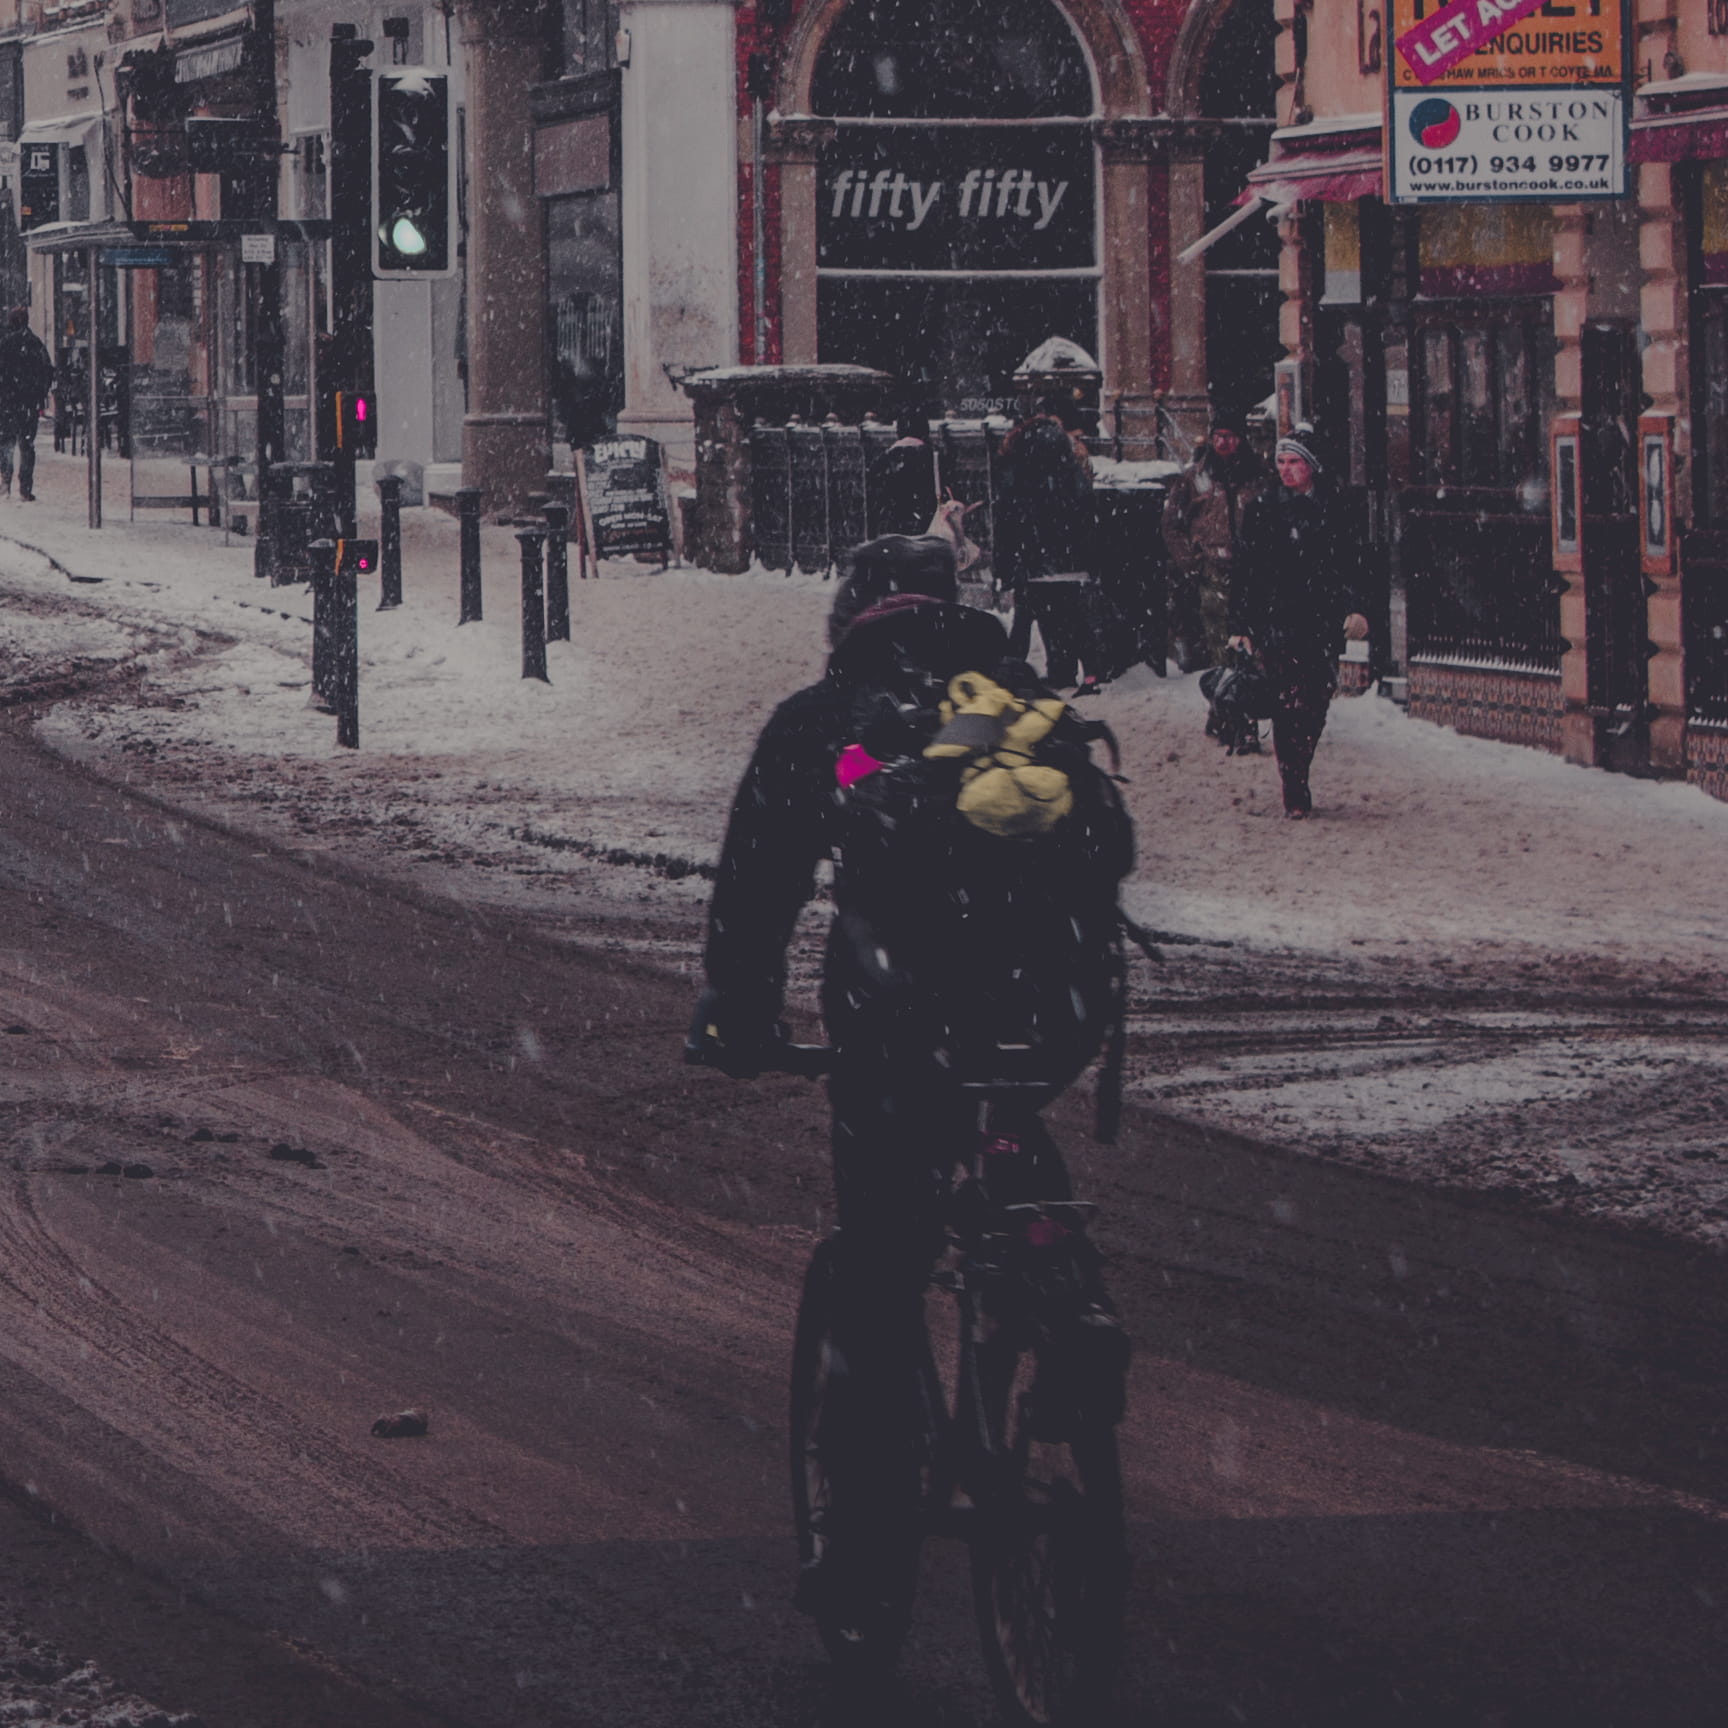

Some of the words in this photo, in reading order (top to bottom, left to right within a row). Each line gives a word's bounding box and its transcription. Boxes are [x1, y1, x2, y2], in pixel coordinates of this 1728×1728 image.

[1414, 12, 1474, 66] LET
[1519, 68, 1536, 79] OR
[1539, 68, 1546, 79] T
[1466, 102, 1609, 121] BURSTON
[1492, 124, 1579, 143] COOK
[1409, 155, 1478, 176] (0117)
[1489, 155, 1536, 172] 934
[1549, 154, 1610, 172] 9977
[1409, 179, 1610, 192] www.burstoncook.co.uk
[831, 169, 943, 232] fifty
[958, 169, 1070, 232] fifty
